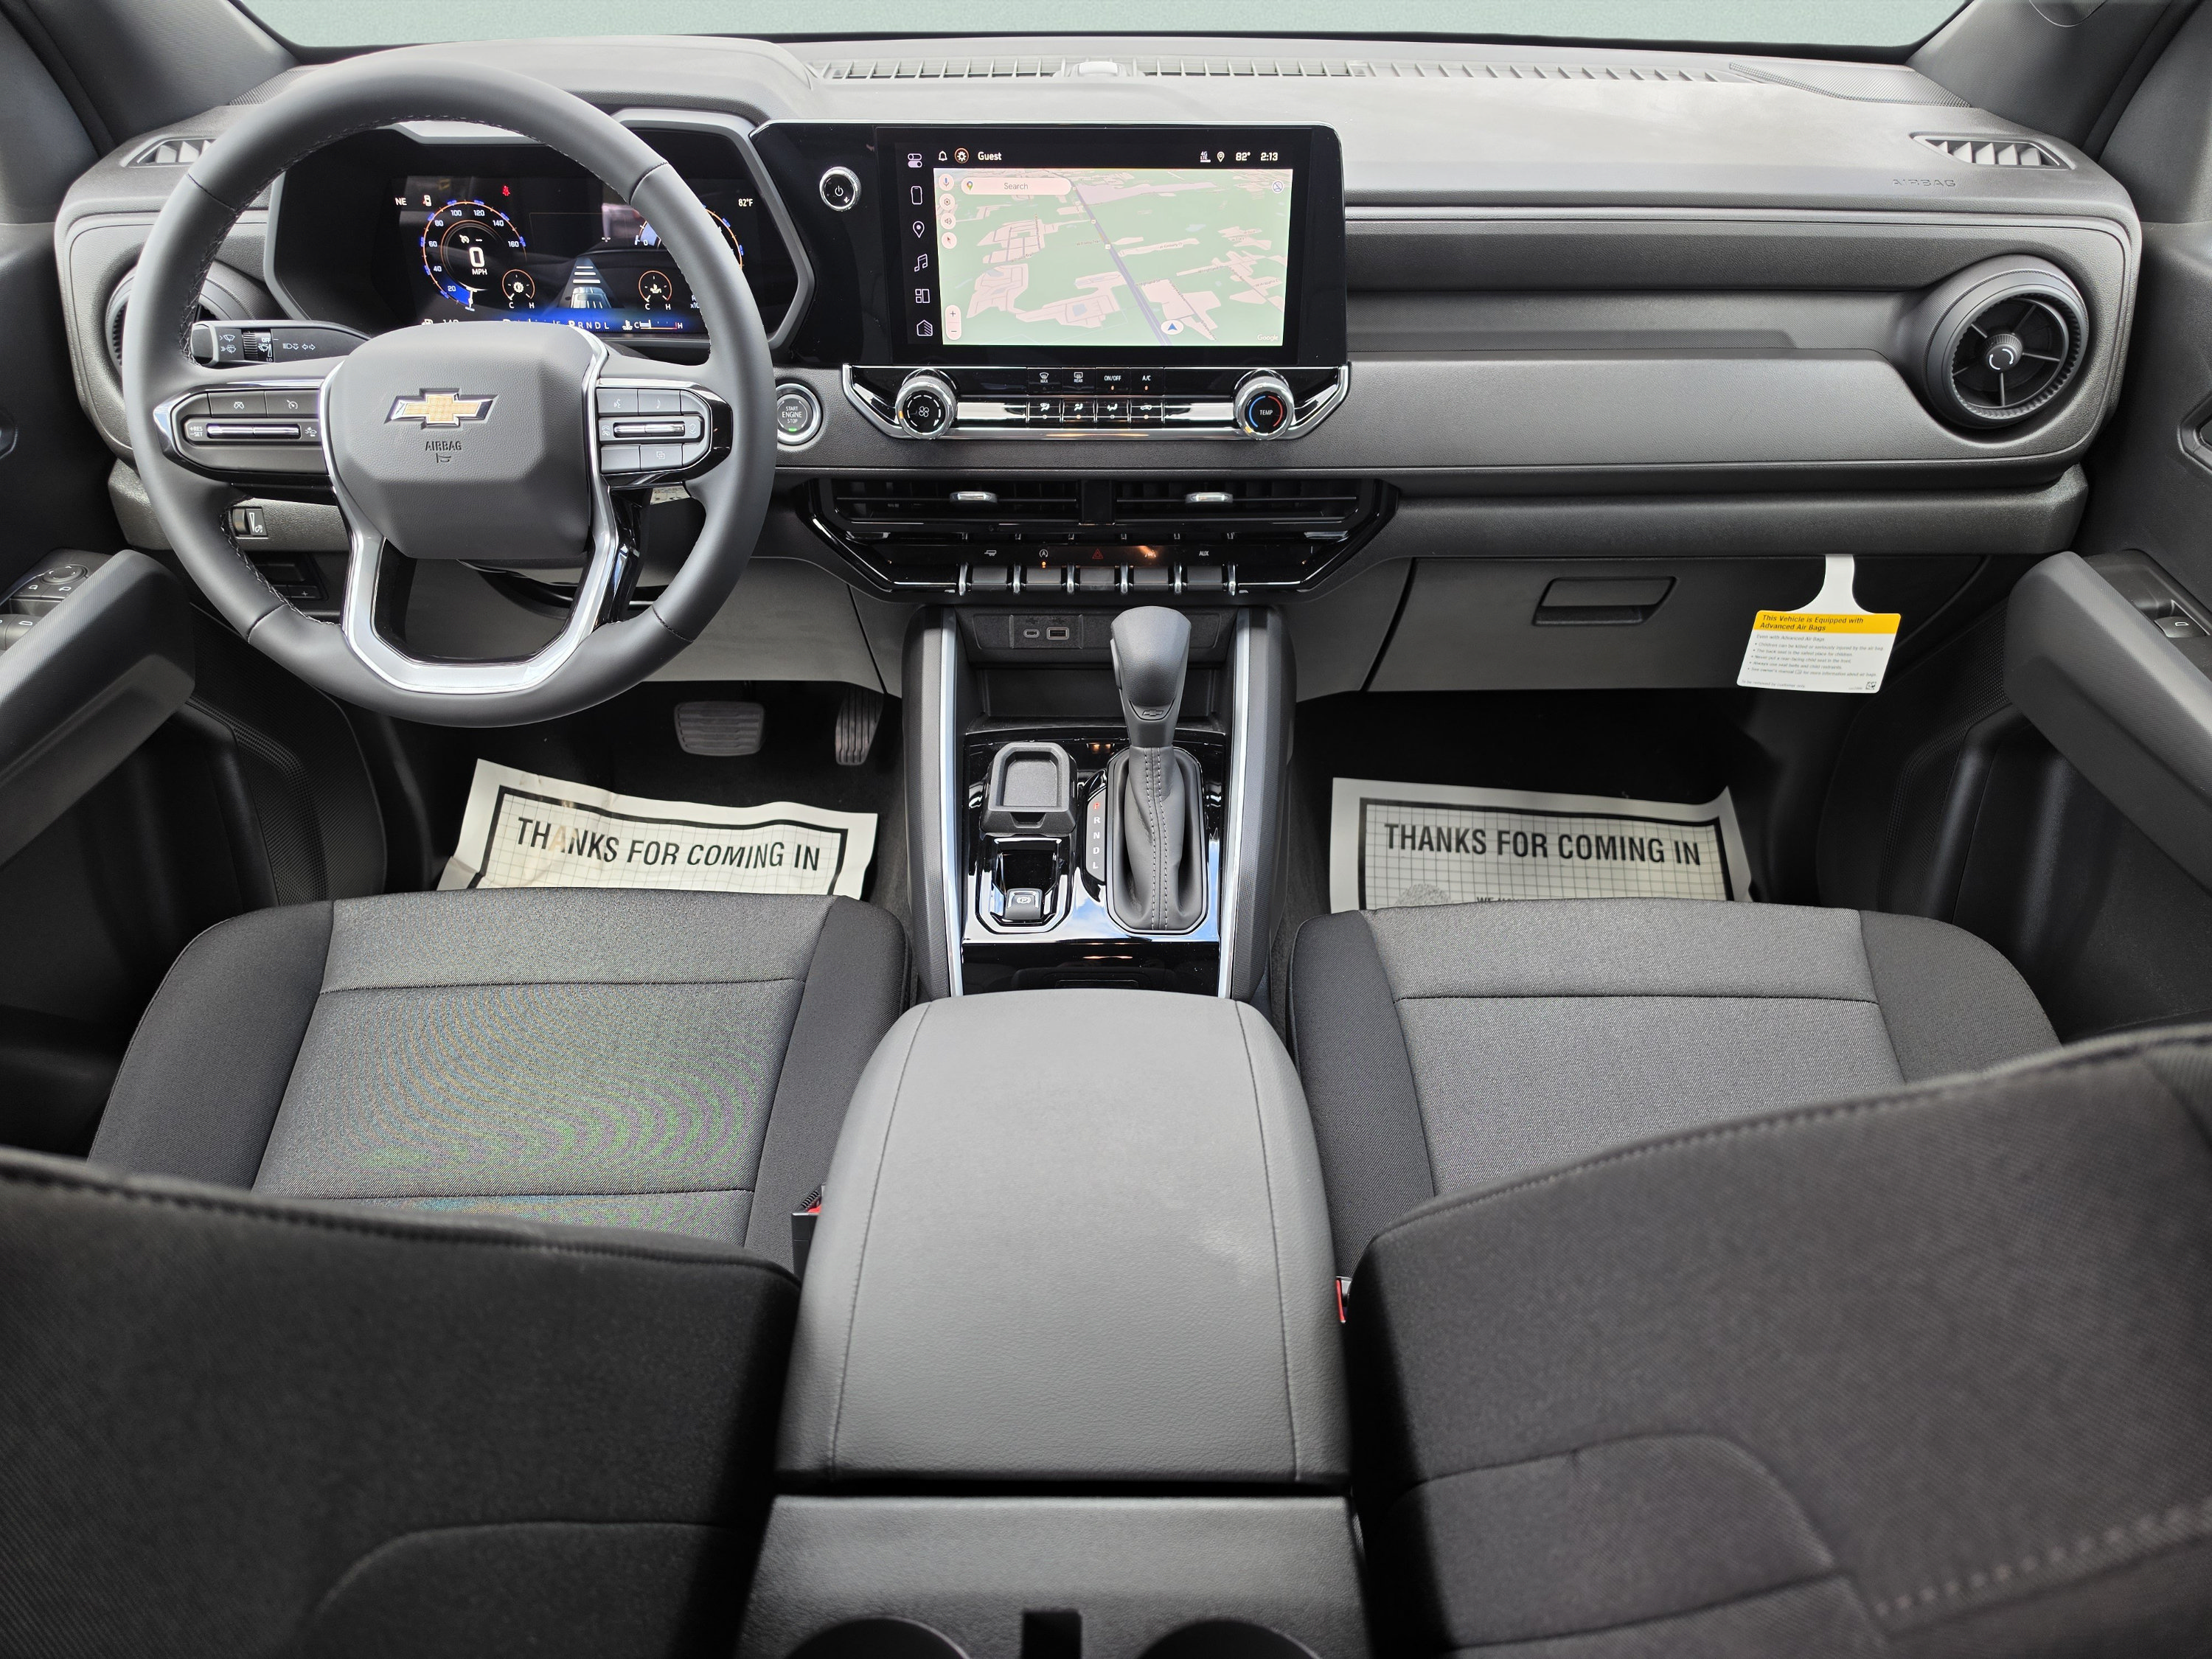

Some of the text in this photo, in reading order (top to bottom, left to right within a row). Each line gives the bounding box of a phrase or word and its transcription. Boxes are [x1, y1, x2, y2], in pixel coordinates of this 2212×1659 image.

[978, 151, 1002, 161] Guest
[1260, 152, 1278, 161] 2:13
[395, 198, 407, 206] NE
[738, 198, 753, 207] 82°F
[469, 247, 485, 267] 0
[425, 441, 462, 451] AIRBAG
[517, 816, 820, 872] THANKS FOR COMING IN
[1384, 822, 1701, 866] THANKS FOR COMING IN
